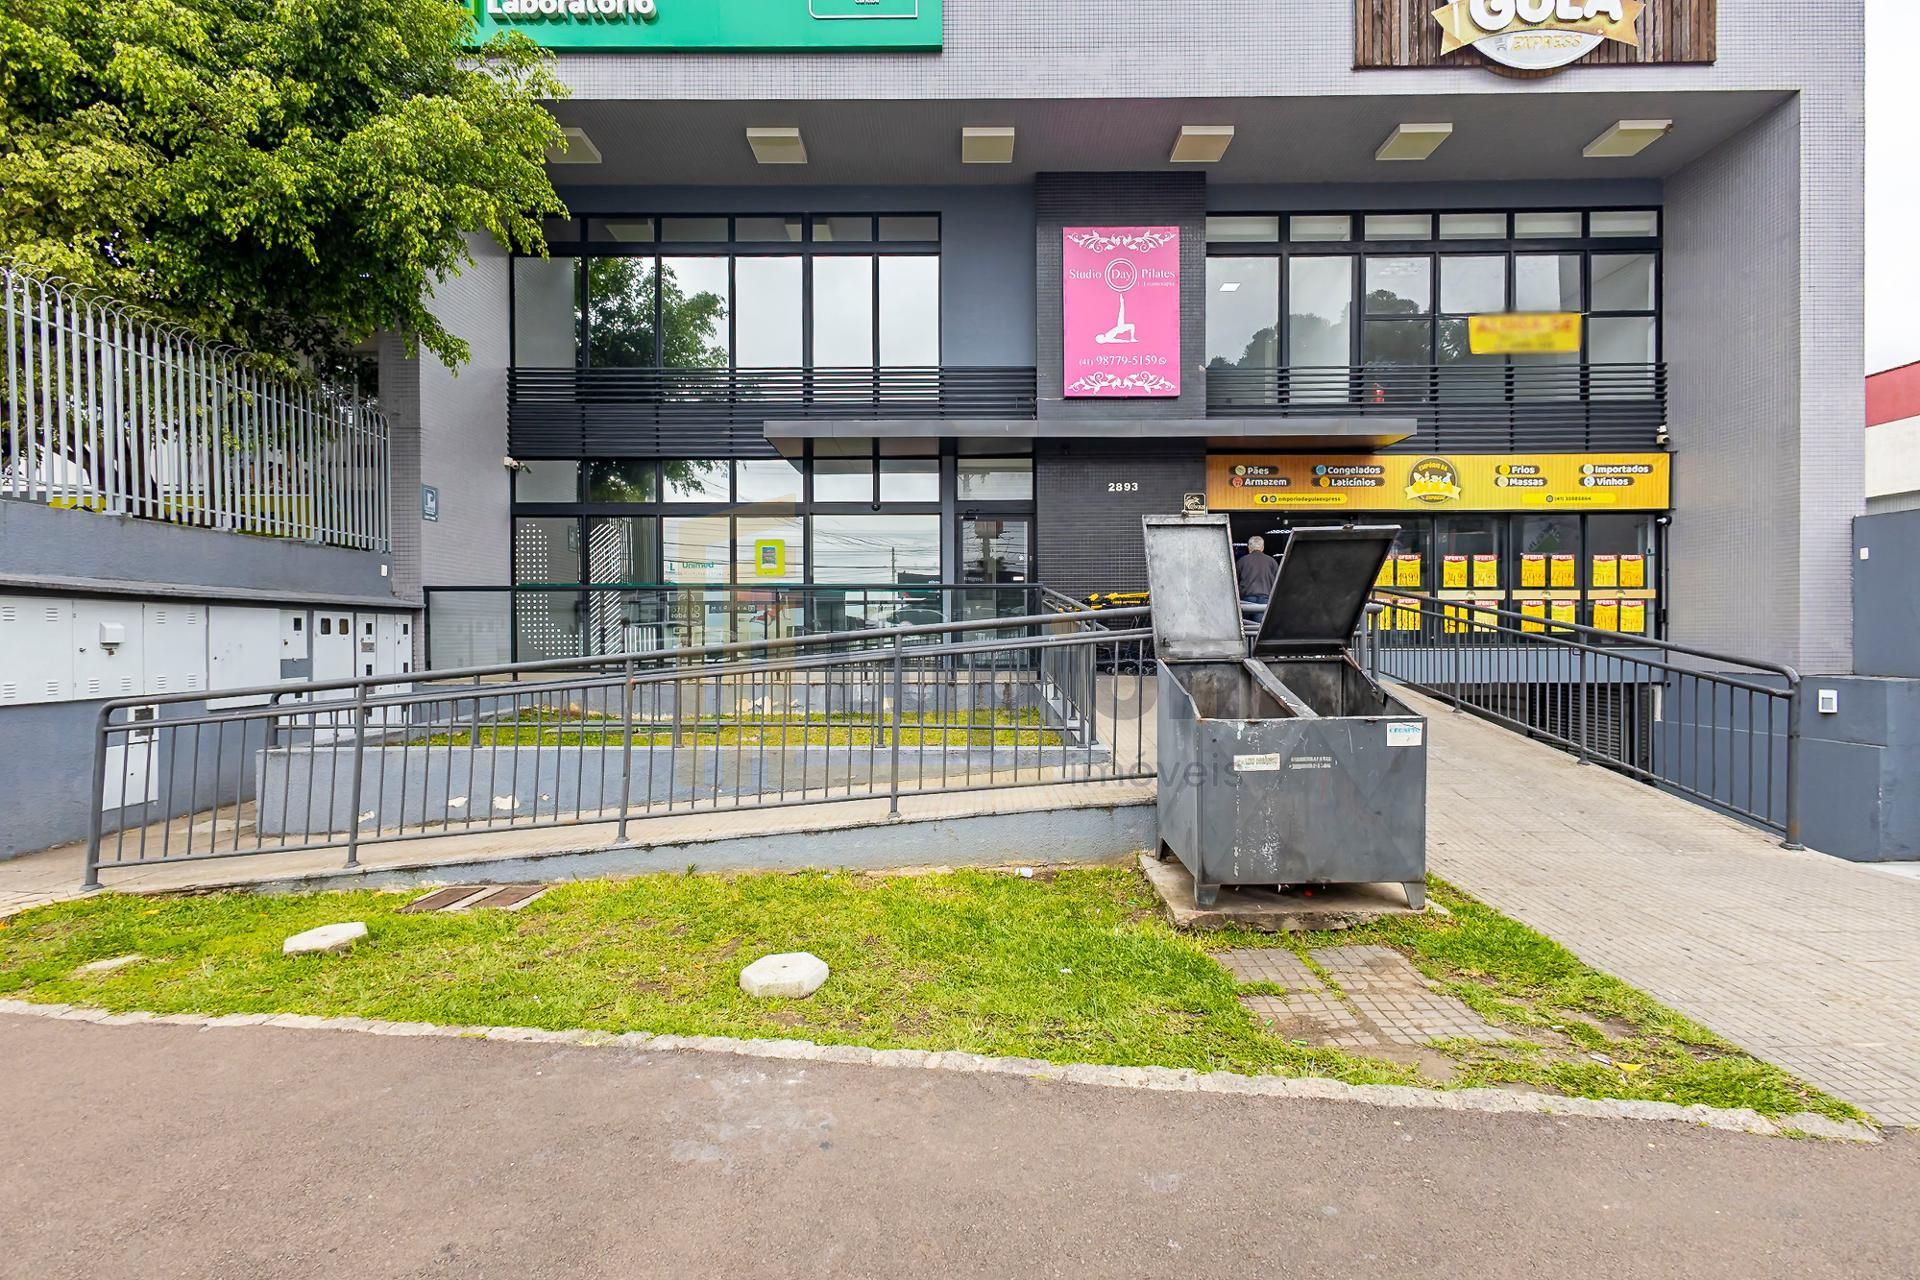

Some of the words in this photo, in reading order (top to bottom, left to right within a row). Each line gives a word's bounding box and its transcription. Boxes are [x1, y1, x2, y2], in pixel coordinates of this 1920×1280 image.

[1069, 268, 1102, 280] Studio
[1111, 268, 1132, 282] Day
[1140, 268, 1176, 279] Pilates
[1096, 355, 1158, 366] 98779-5159
[1247, 466, 1269, 475] Pães
[1327, 466, 1380, 476] Congelados
[1511, 466, 1536, 474] Frios
[1595, 465, 1649, 475] Importados
[1244, 477, 1287, 486] Armazem
[1331, 477, 1376, 487] Laticínios
[1509, 477, 1544, 486] Massas
[1597, 476, 1629, 486] Vinhos
[1108, 482, 1139, 492] 2893
